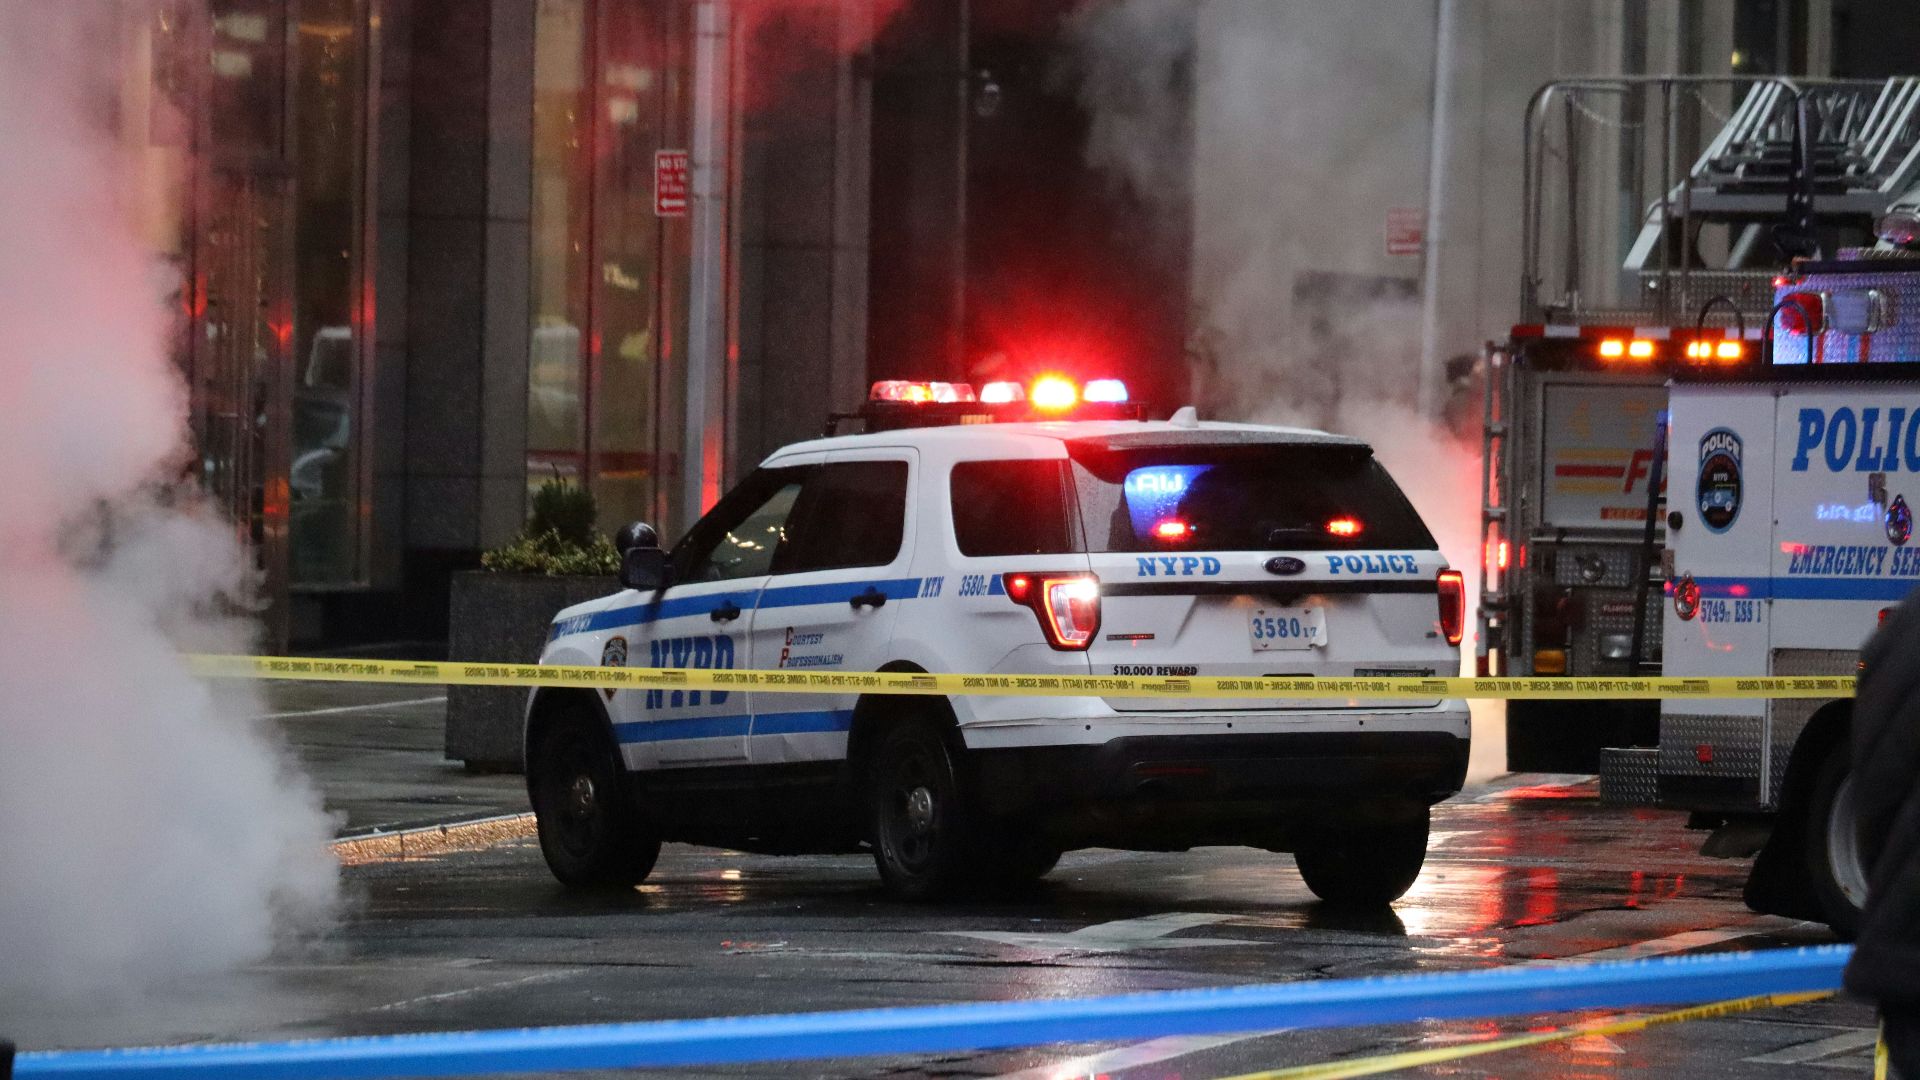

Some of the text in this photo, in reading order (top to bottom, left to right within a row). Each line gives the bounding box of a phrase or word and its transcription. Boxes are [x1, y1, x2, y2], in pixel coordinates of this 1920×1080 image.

[660, 159, 672, 169] NO
[1702, 433, 1740, 461] POLICE
[1712, 472, 1729, 482] NYPD
[1136, 556, 1221, 577] NYPD
[1325, 554, 1419, 575] POLICE
[1788, 544, 1888, 576] EMERGENCY
[958, 574, 985, 596] 3580
[1735, 600, 1753, 623] ESS
[1252, 617, 1317, 639] 3580 17
[778, 647, 844, 668] PROFESSIONALISM
[645, 635, 735, 710] NYPD
[1113, 664, 1198, 677] $10,000 REWARD
